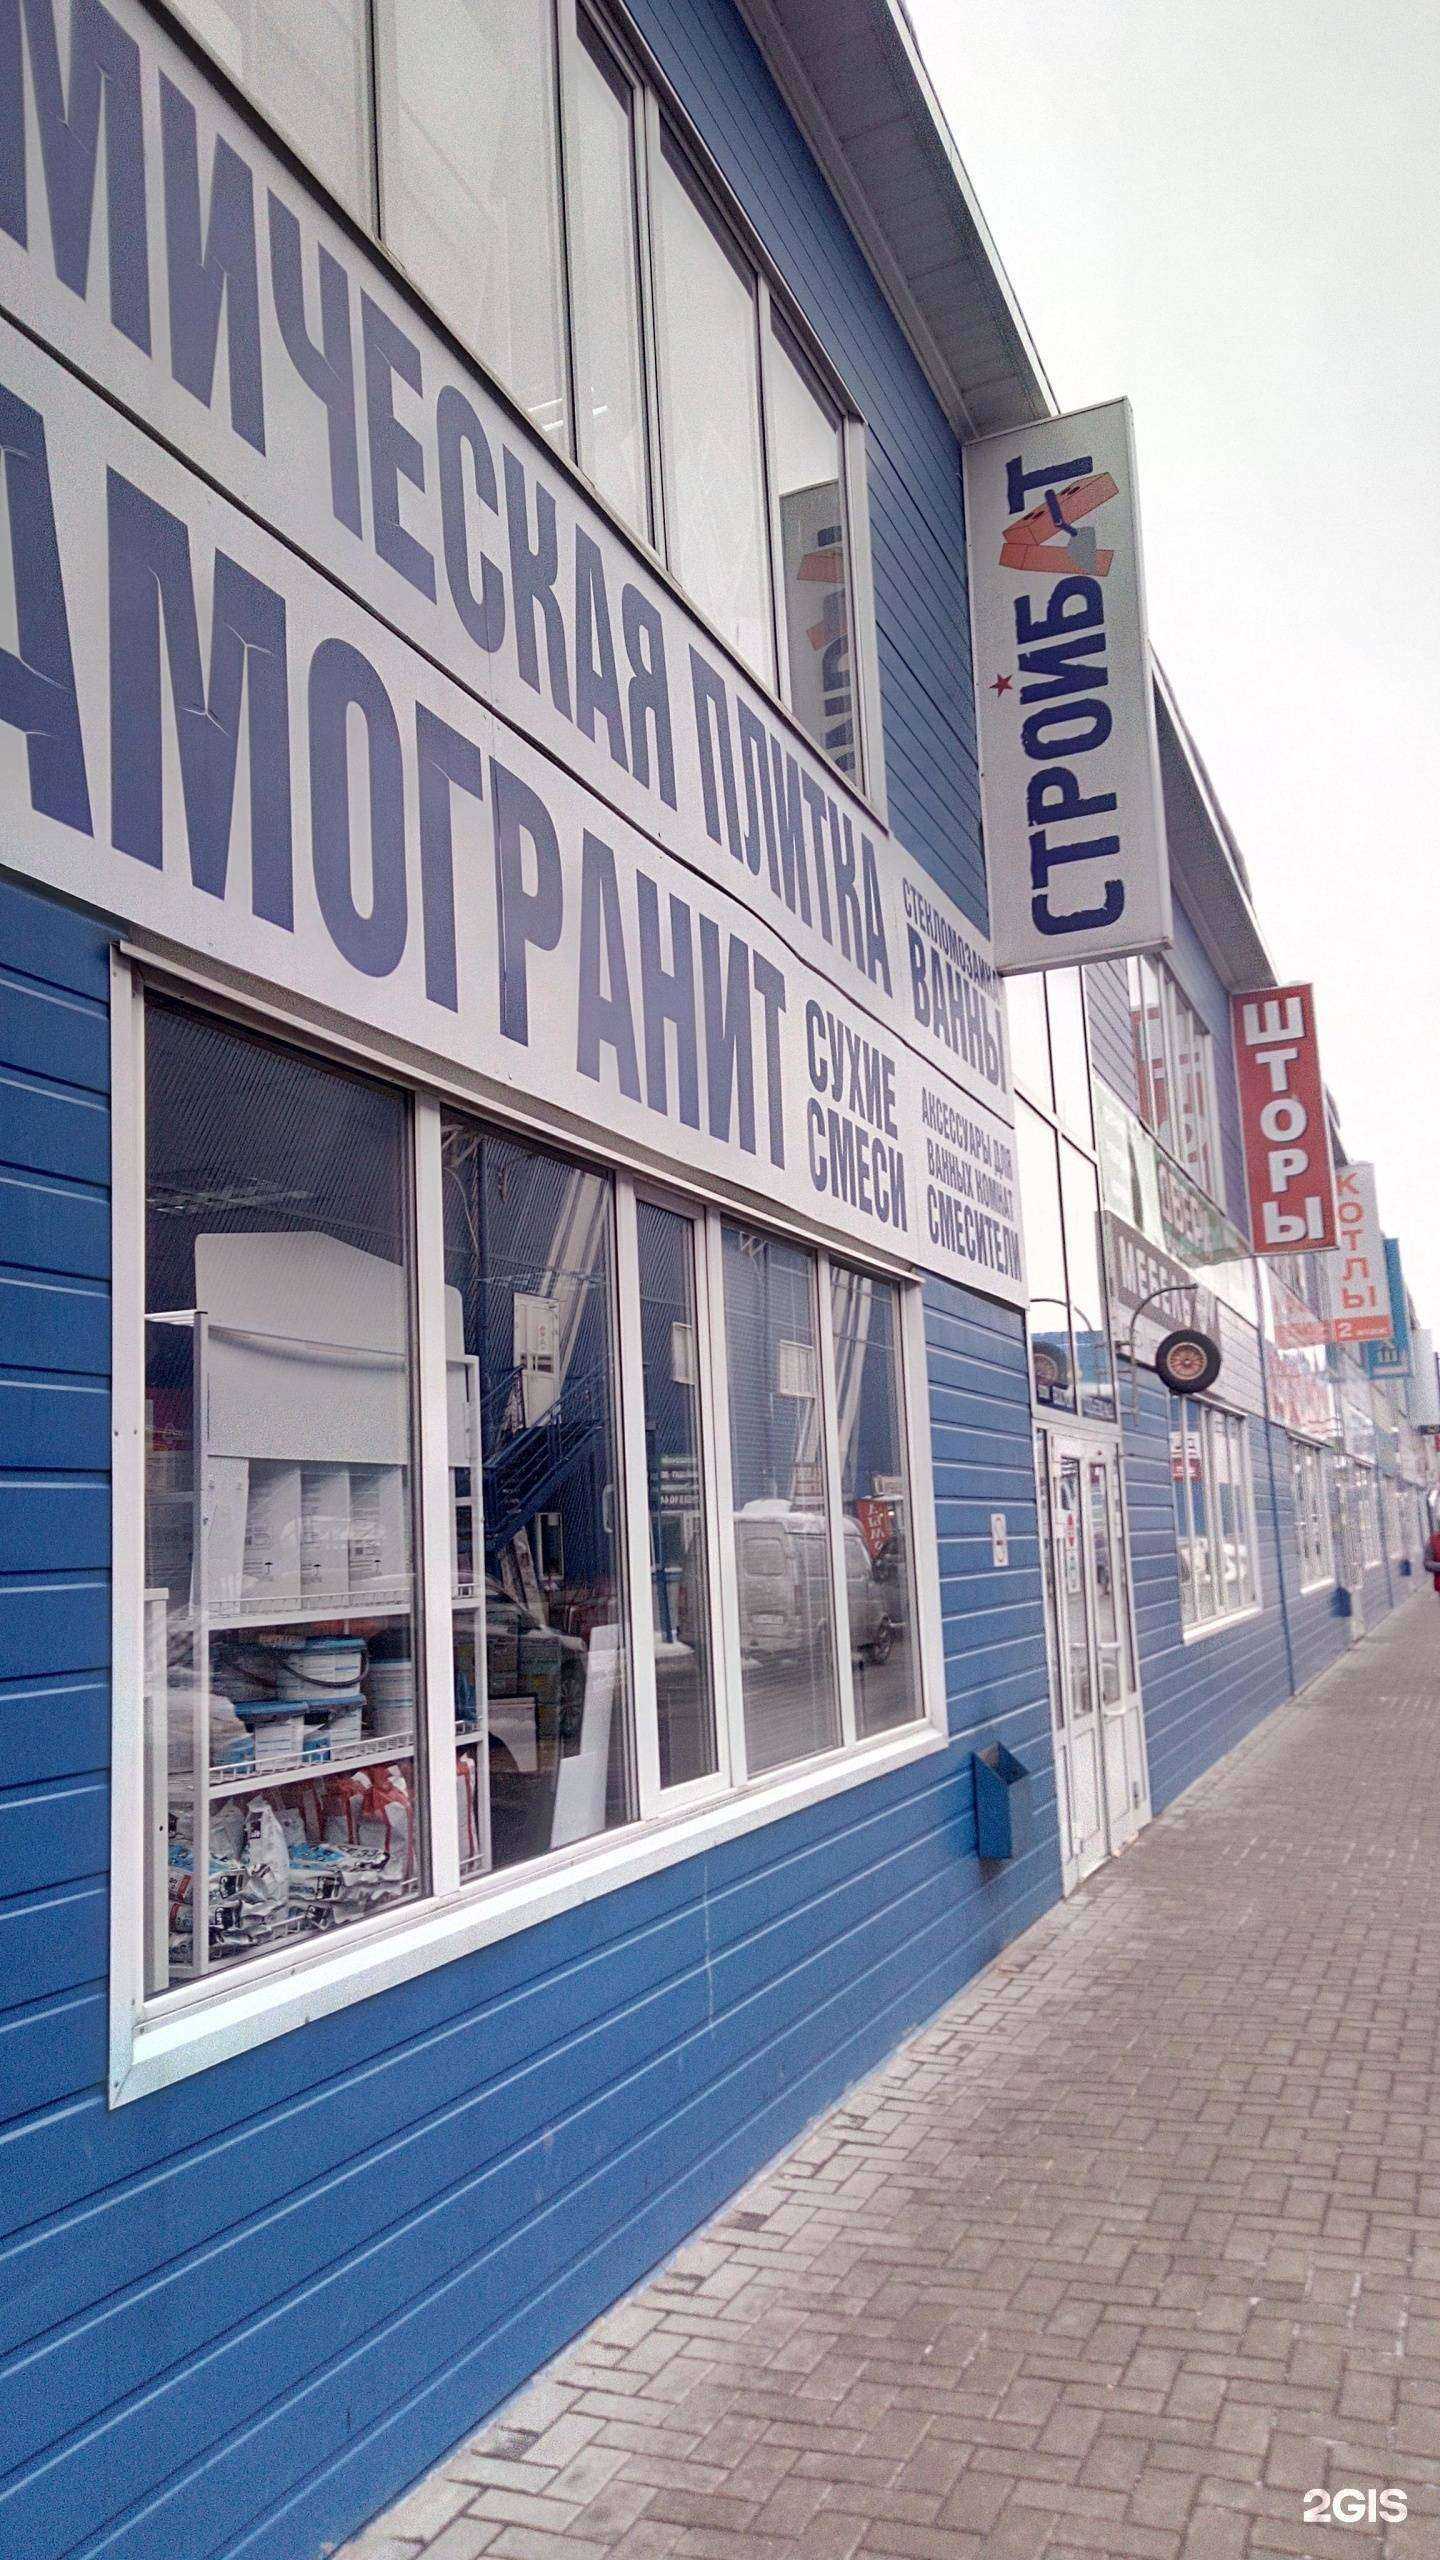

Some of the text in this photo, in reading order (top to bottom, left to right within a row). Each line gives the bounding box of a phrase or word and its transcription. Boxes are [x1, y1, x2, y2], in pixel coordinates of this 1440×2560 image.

[689, 643, 893, 999] ПЛИТКА
[805, 999, 898, 1140] СУХИЕ
[907, 923, 1007, 1093] ВАННЫ
[807, 1096, 908, 1232] СМЕСИ
[921, 1086, 992, 1168] АКСЕССУАРЫ
[926, 1138, 974, 1200] ВАННЫХ
[1242, 996, 1324, 1244] ШТОРЫ
[926, 1184, 1023, 1282] СМЕСИТЕЛИ
[1336, 1172, 1378, 1310] КОТЛЫ
